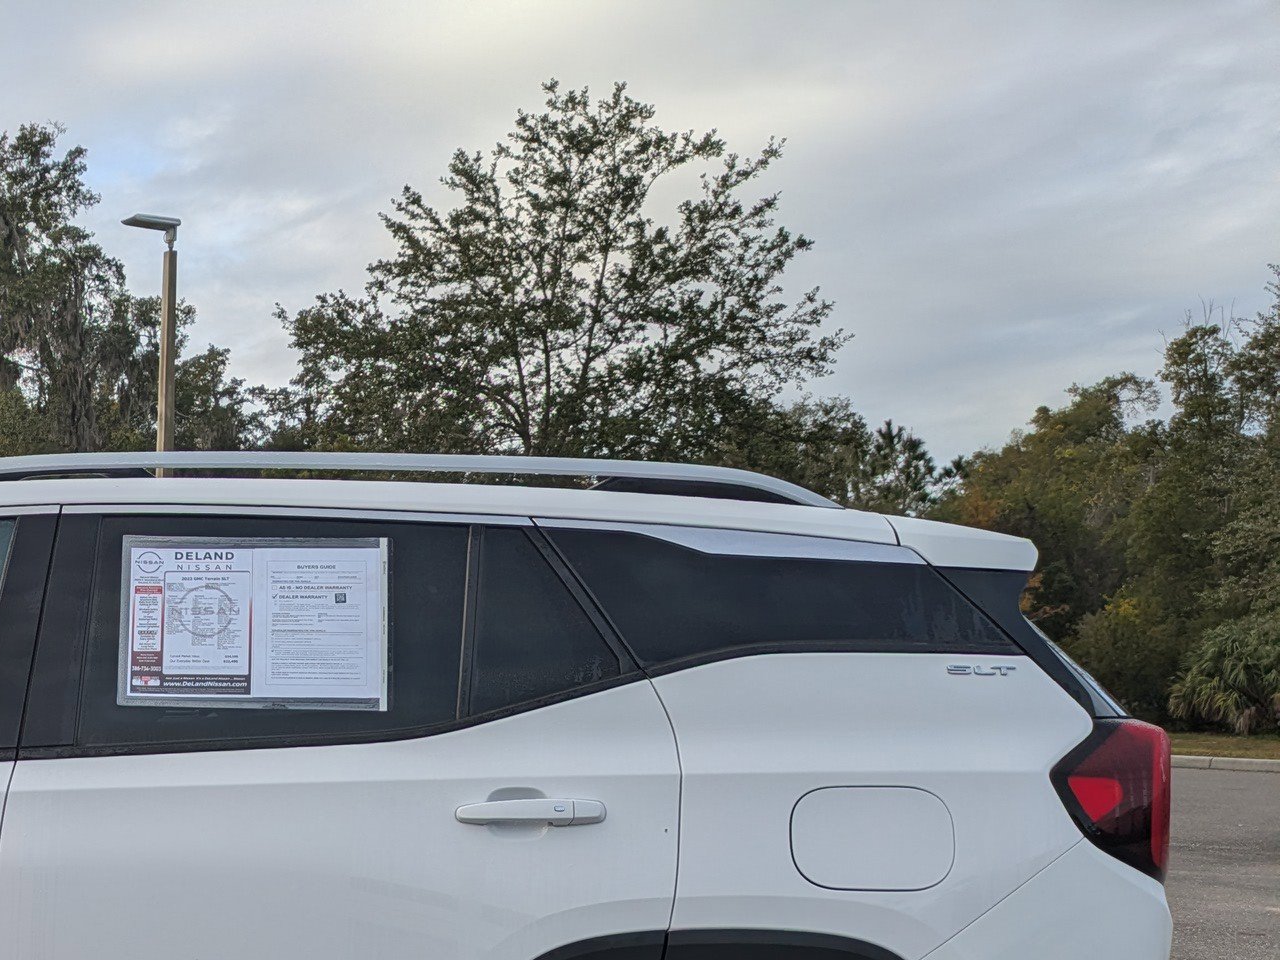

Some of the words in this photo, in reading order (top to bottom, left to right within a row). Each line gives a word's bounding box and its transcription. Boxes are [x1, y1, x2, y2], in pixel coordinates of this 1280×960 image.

[174, 551, 235, 561] DELAND
[171, 606, 240, 616] NISSAN
[946, 664, 1016, 676] SLT
